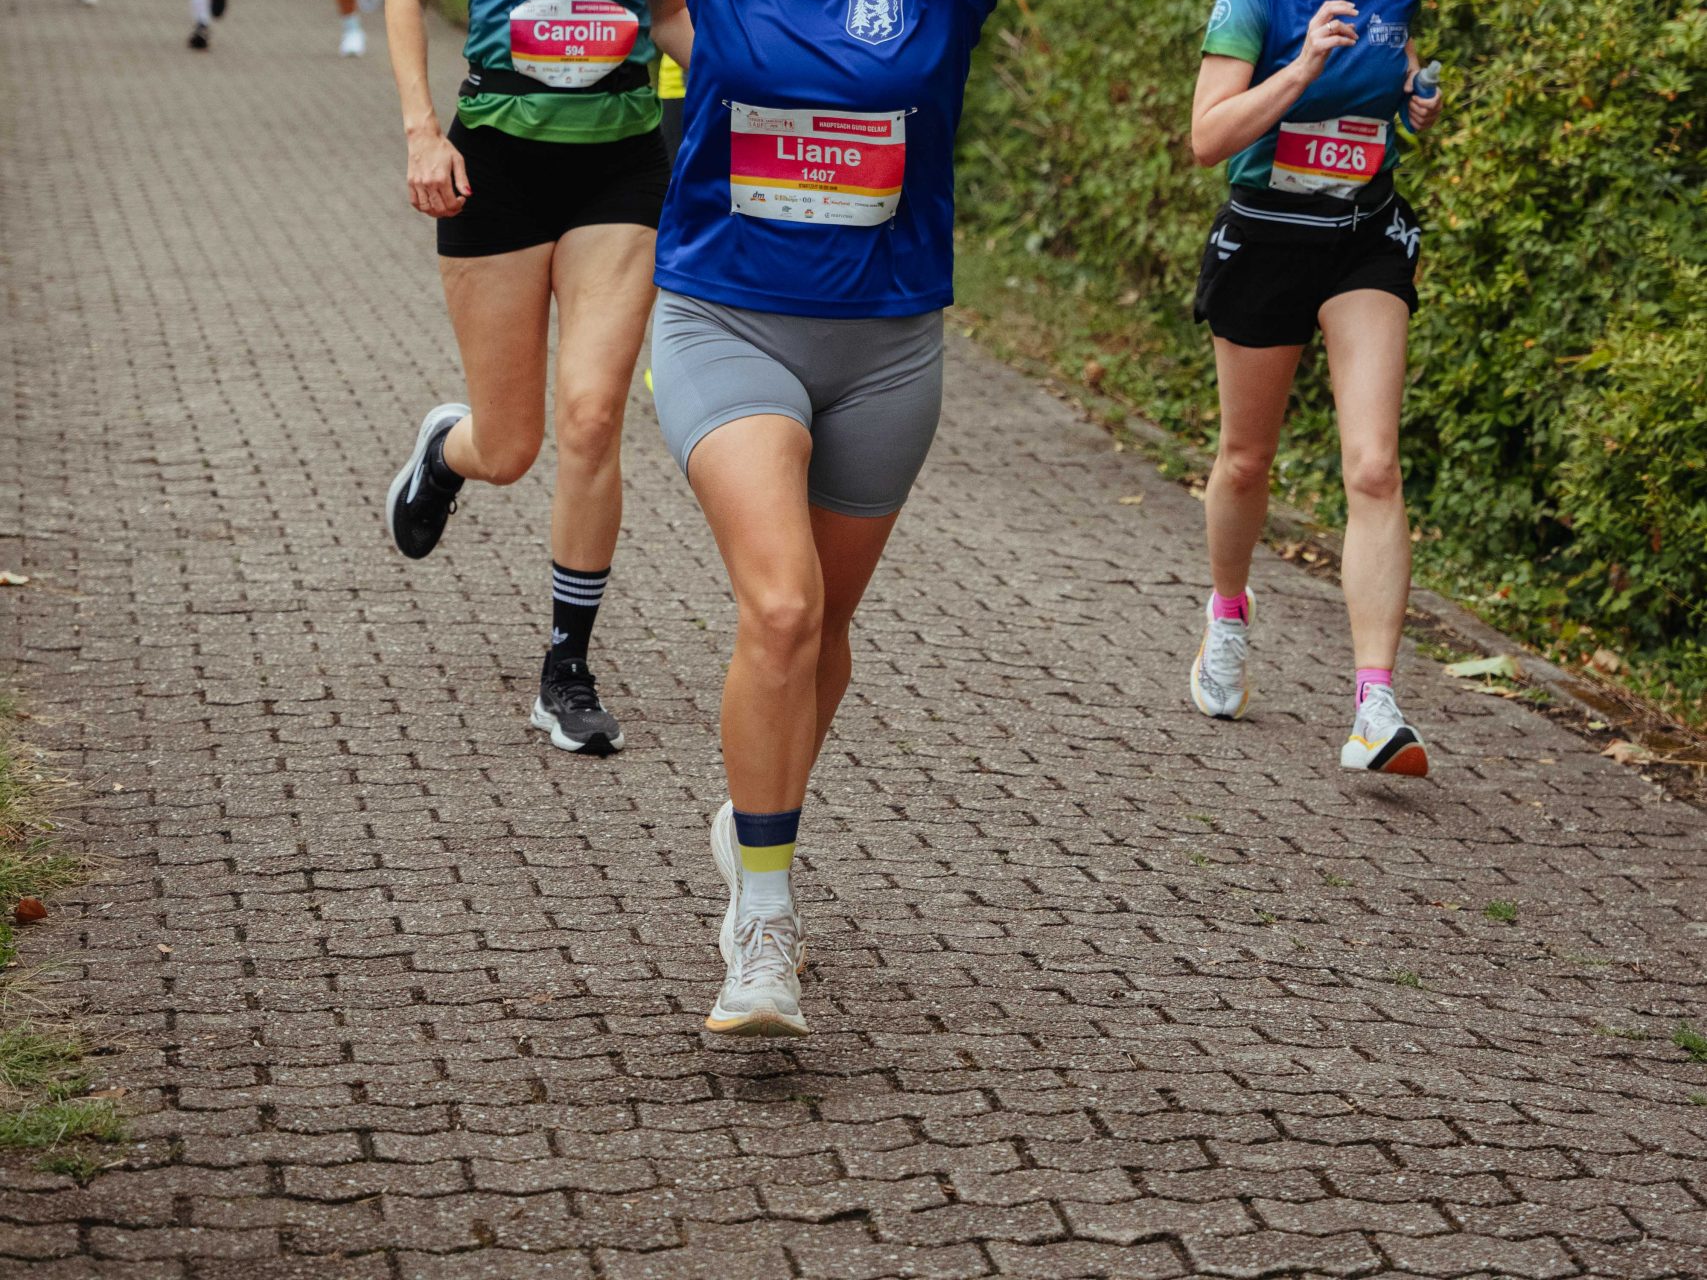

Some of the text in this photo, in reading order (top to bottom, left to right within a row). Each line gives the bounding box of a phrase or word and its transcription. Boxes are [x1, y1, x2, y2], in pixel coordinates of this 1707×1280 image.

[533, 21, 616, 42] Carolin
[565, 45, 585, 56] 594
[819, 121, 851, 130] HAUPTSACH
[777, 137, 861, 167] Liane
[1305, 139, 1367, 171] 1626
[802, 168, 836, 183] 1407
